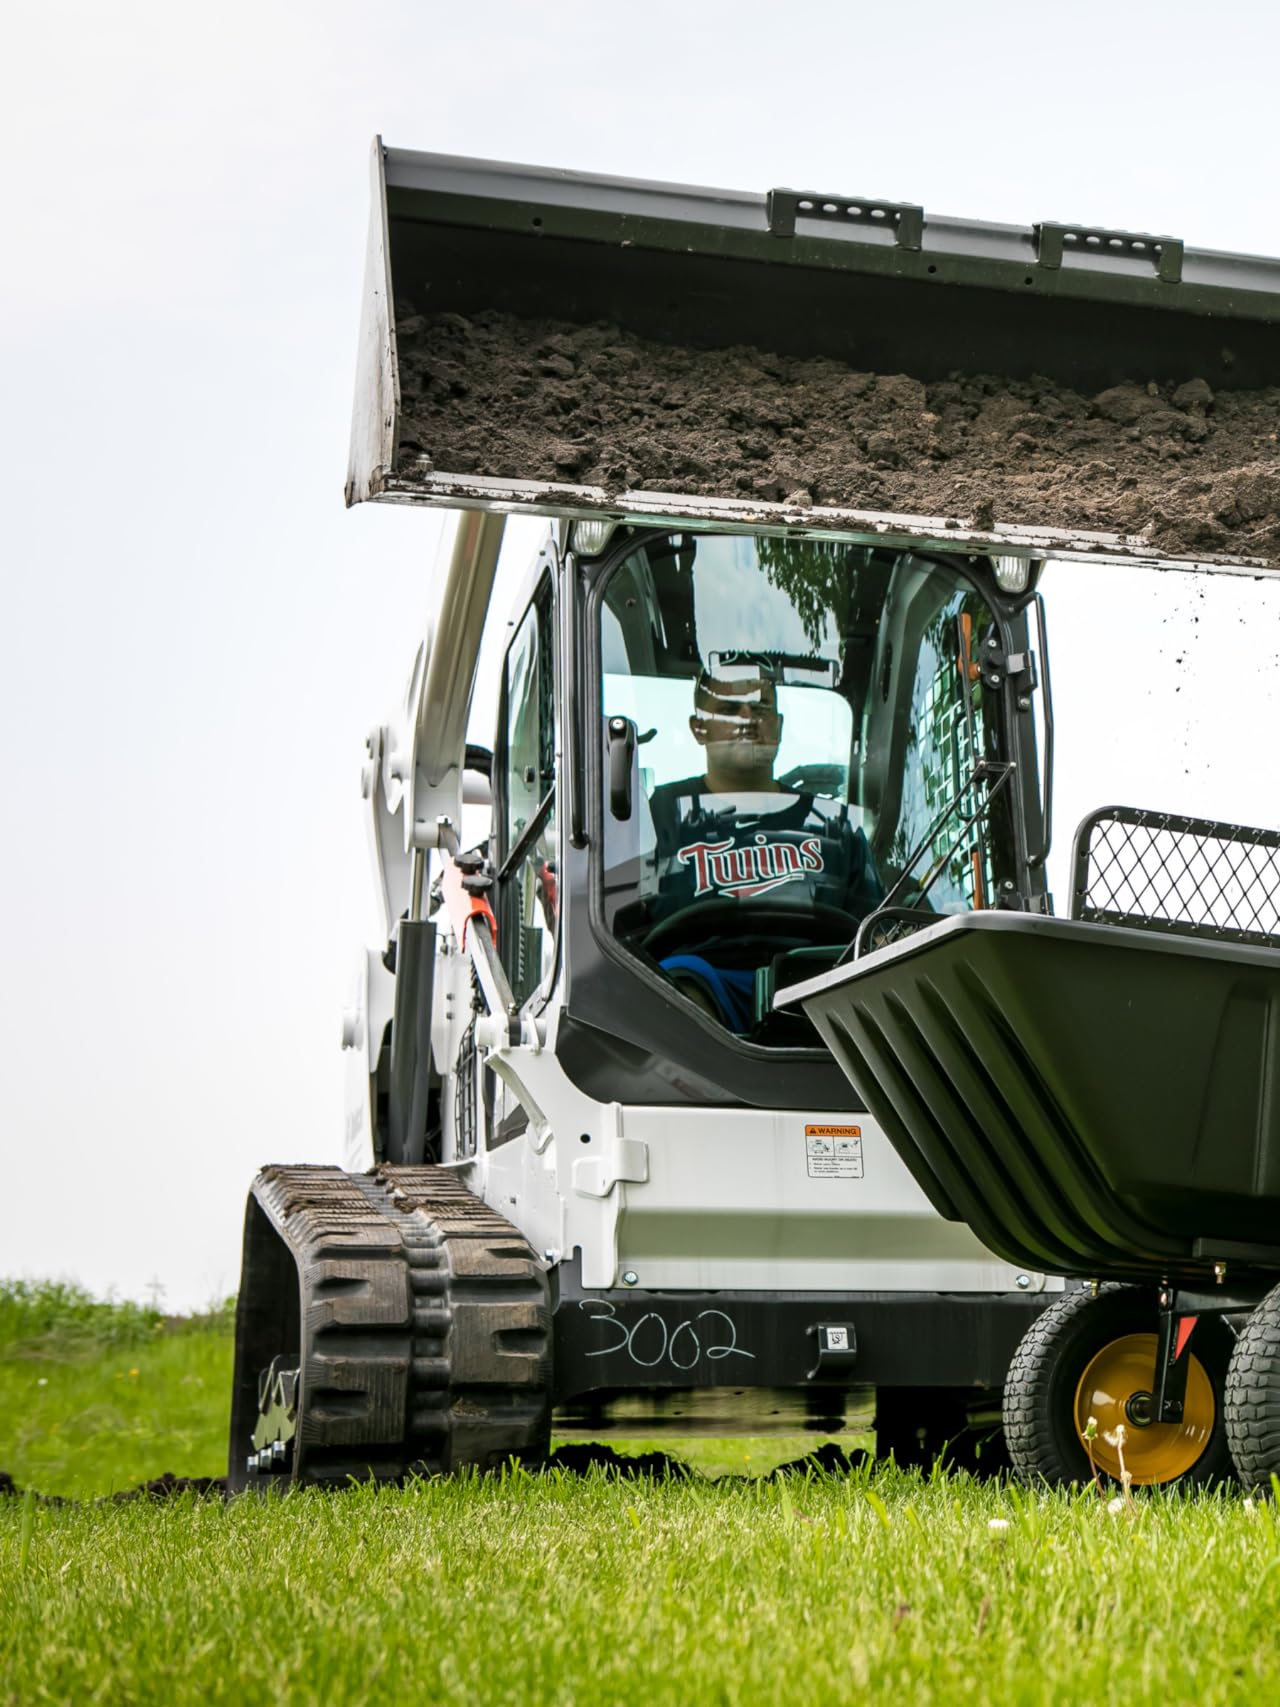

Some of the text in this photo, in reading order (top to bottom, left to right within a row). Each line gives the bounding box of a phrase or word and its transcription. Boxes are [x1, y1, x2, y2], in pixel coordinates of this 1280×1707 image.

[677, 834, 824, 897] Twins
[817, 1127, 857, 1135] WARNING
[579, 1299, 756, 1369] 3002
